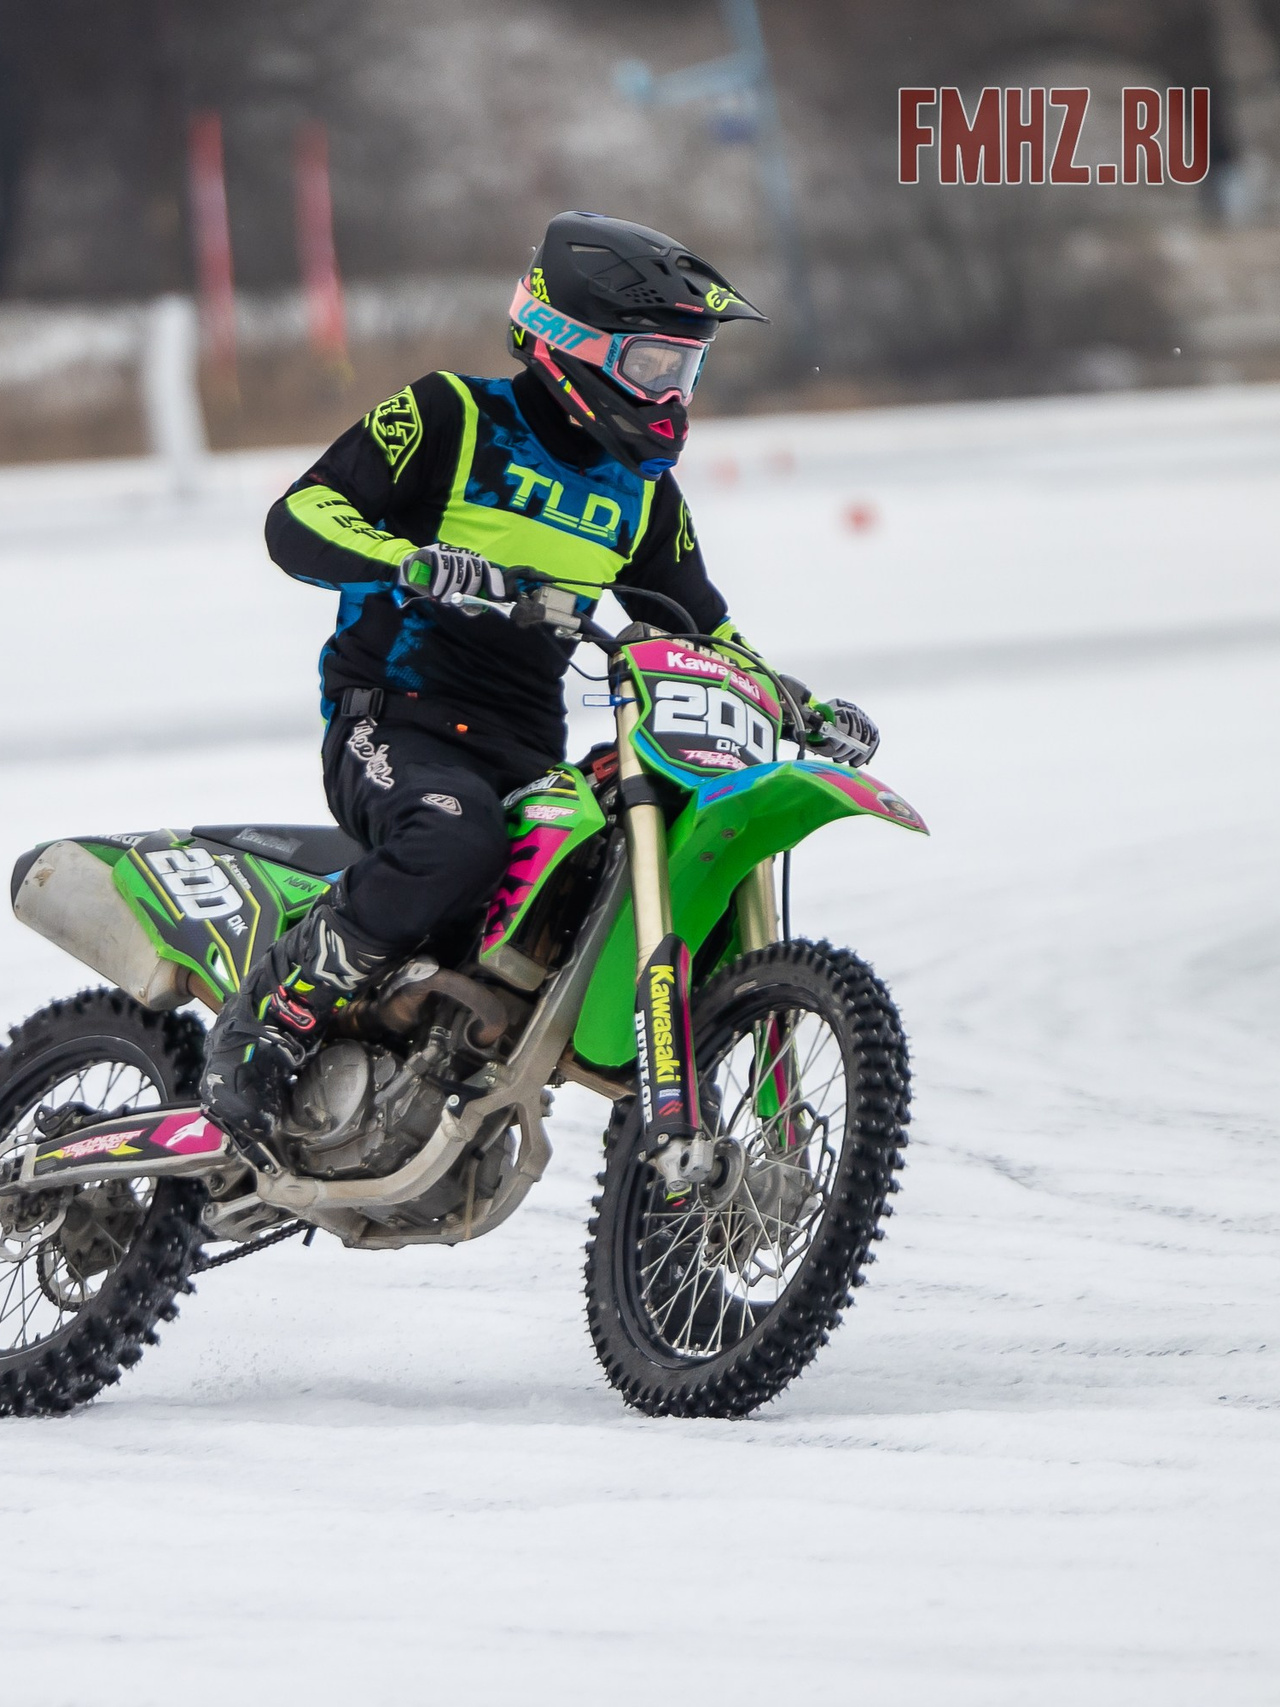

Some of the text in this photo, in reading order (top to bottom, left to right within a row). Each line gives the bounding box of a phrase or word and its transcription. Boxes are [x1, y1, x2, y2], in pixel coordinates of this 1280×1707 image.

[506, 462, 621, 543] TLD
[666, 650, 761, 700] Kawasaki
[653, 680, 774, 765] 200
[716, 738, 741, 757] OK
[145, 848, 244, 919] 200
[227, 914, 249, 936] OK
[650, 964, 682, 1084] Kawasaki
